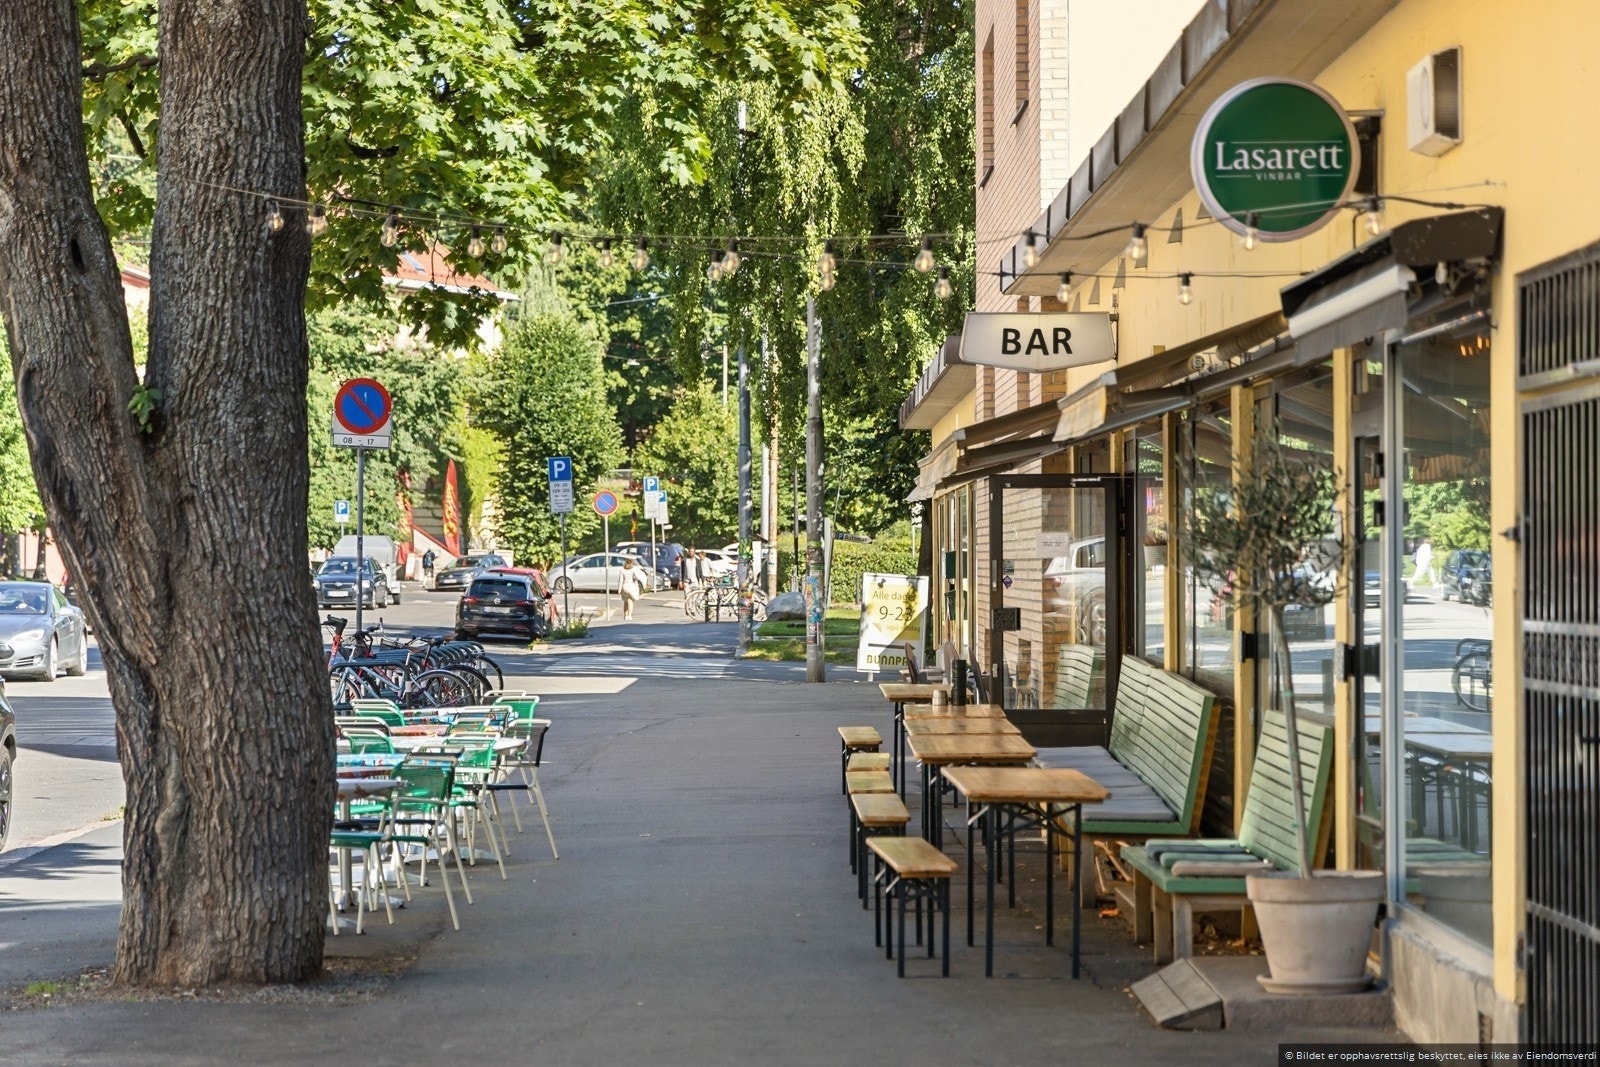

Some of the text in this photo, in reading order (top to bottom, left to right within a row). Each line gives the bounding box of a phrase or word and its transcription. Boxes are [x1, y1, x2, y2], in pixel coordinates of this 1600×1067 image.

[1215, 141, 1344, 170] Lasarett
[1255, 172, 1302, 181] VINBAR
[1001, 327, 1073, 355] BAR
[553, 460, 566, 478] P
[646, 479, 656, 491] P
[338, 501, 347, 514] P
[872, 590, 889, 599] Alle
[879, 605, 913, 621] 9-23
